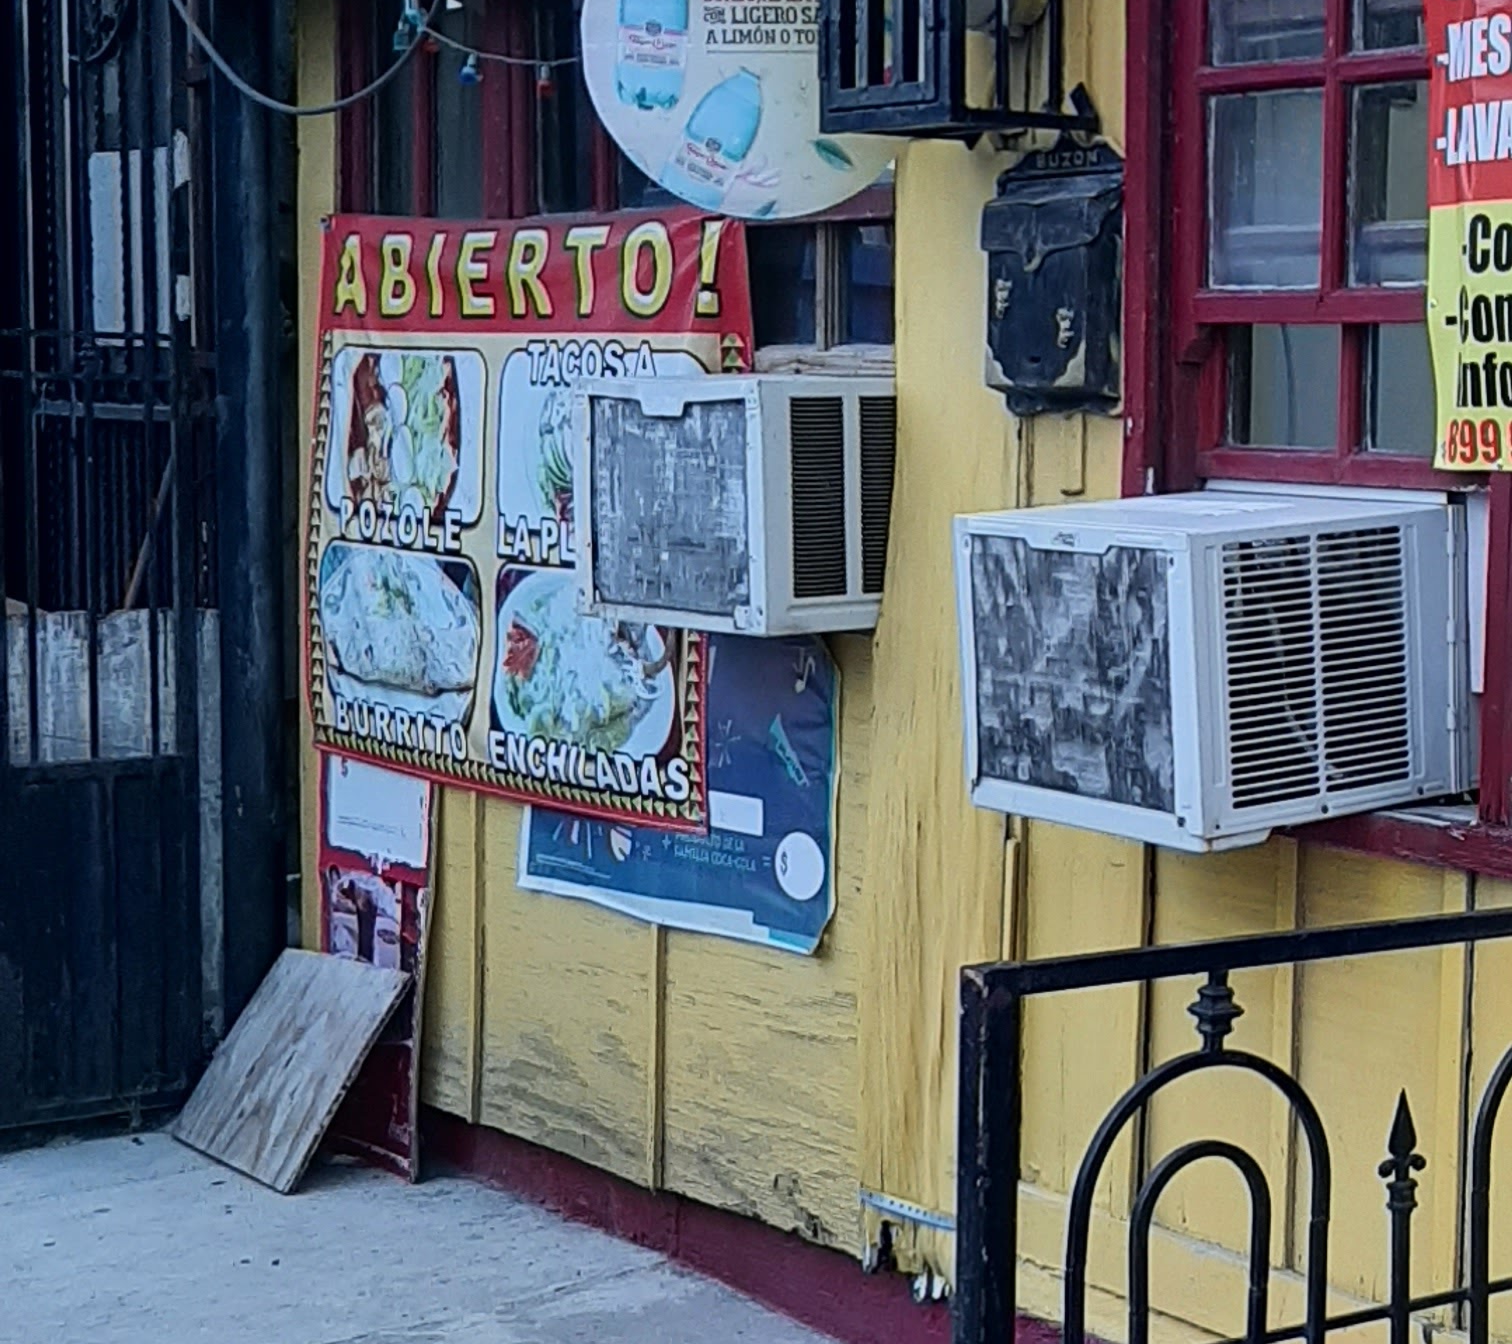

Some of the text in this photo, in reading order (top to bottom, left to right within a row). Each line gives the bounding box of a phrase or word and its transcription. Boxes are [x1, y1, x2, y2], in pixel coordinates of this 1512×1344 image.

[705, 29, 718, 46] A
[721, 26, 776, 46] LIMÓN
[731, 5, 798, 25] LIGERO
[333, 219, 725, 319] ABIERTO!
[525, 341, 628, 388] TACOS
[338, 497, 463, 553] POZOLE
[497, 513, 532, 560] LA
[335, 695, 469, 762] BURRITO
[488, 729, 692, 804] ENCHILADAS
